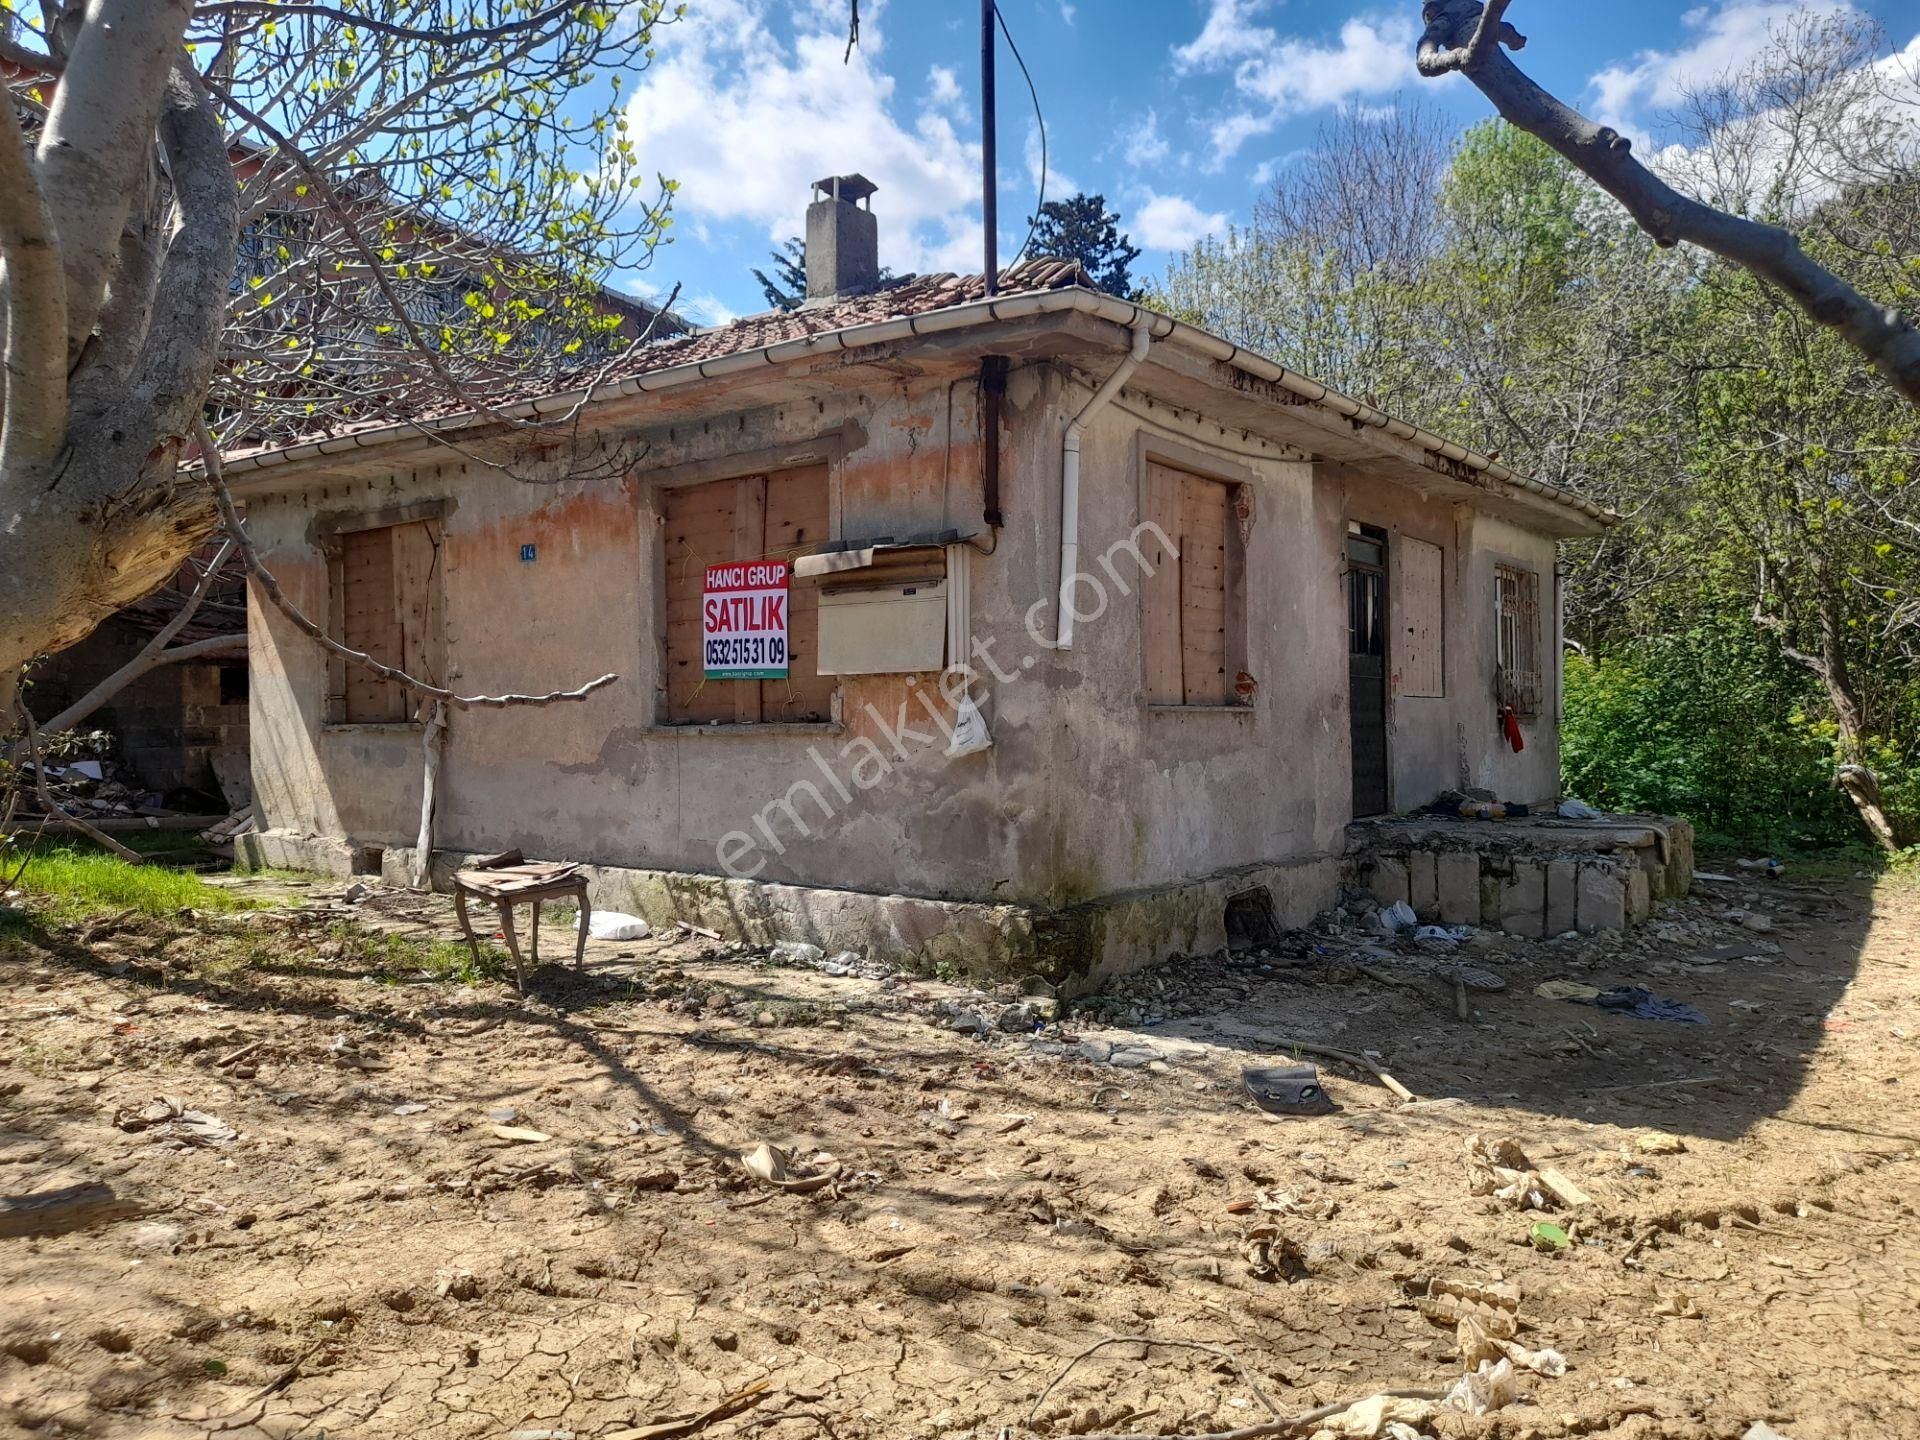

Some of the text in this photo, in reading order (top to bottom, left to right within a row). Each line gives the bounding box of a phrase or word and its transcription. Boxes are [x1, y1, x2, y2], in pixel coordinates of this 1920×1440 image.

[523, 546, 534, 559] 14
[706, 565, 785, 588] HANCI GRUP
[705, 595, 785, 633] SATILIK
[706, 637, 785, 665] 0532 515 31 09
